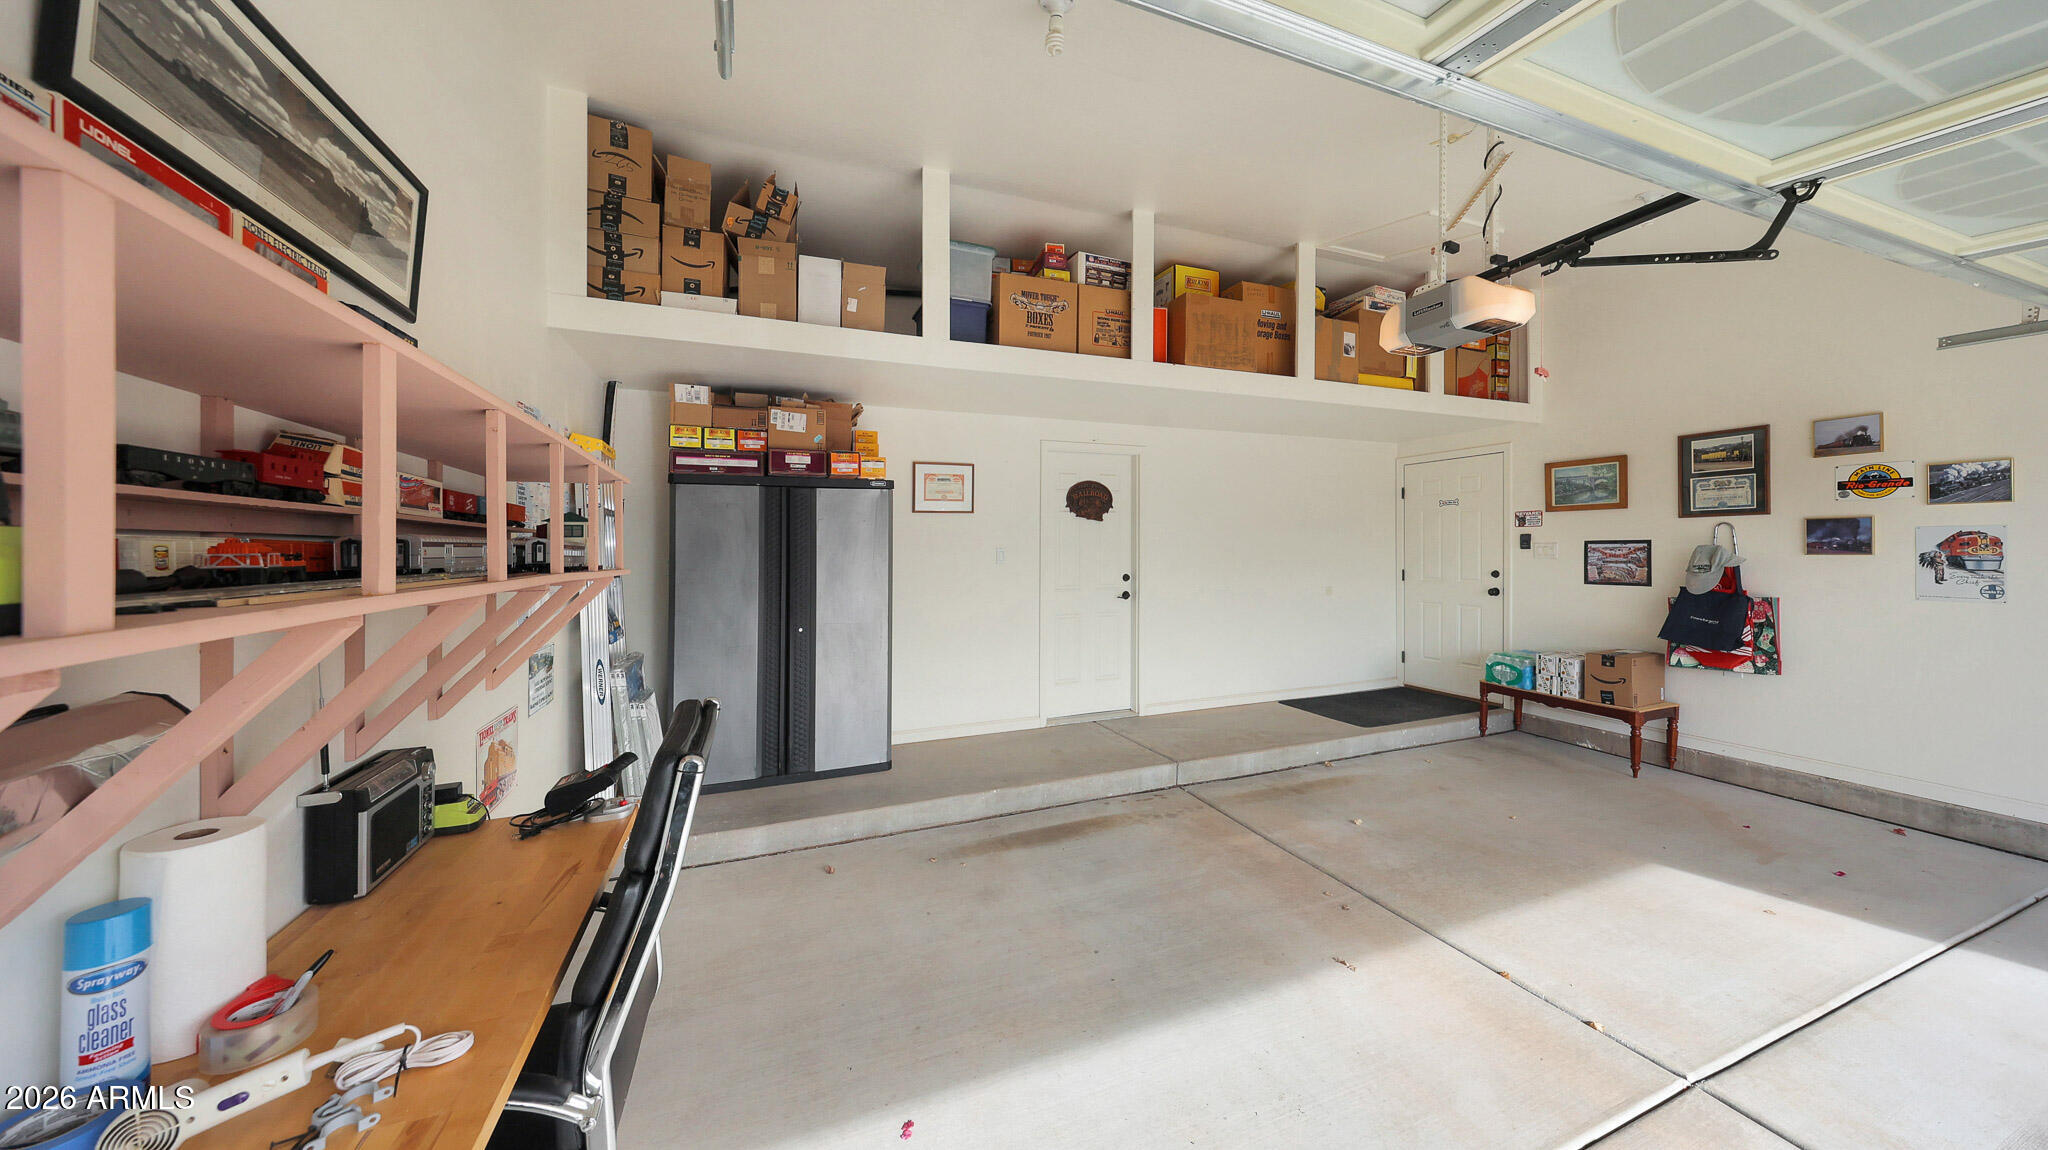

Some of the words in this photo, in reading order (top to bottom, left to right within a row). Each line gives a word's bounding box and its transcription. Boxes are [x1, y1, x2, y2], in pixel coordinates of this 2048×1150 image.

[79, 117, 137, 164] LIONEL
[1026, 310, 1054, 326] BOXES
[1257, 329, 1273, 340] orage
[1276, 322, 1287, 331] and
[1855, 465, 1874, 477] MAIN
[1878, 466, 1896, 475] LINE
[1842, 481, 1865, 490] Rio
[1867, 478, 1910, 488] Grande
[76, 963, 142, 992] Sprayway
[87, 998, 128, 1031] glass
[78, 1017, 135, 1054] cleaner
